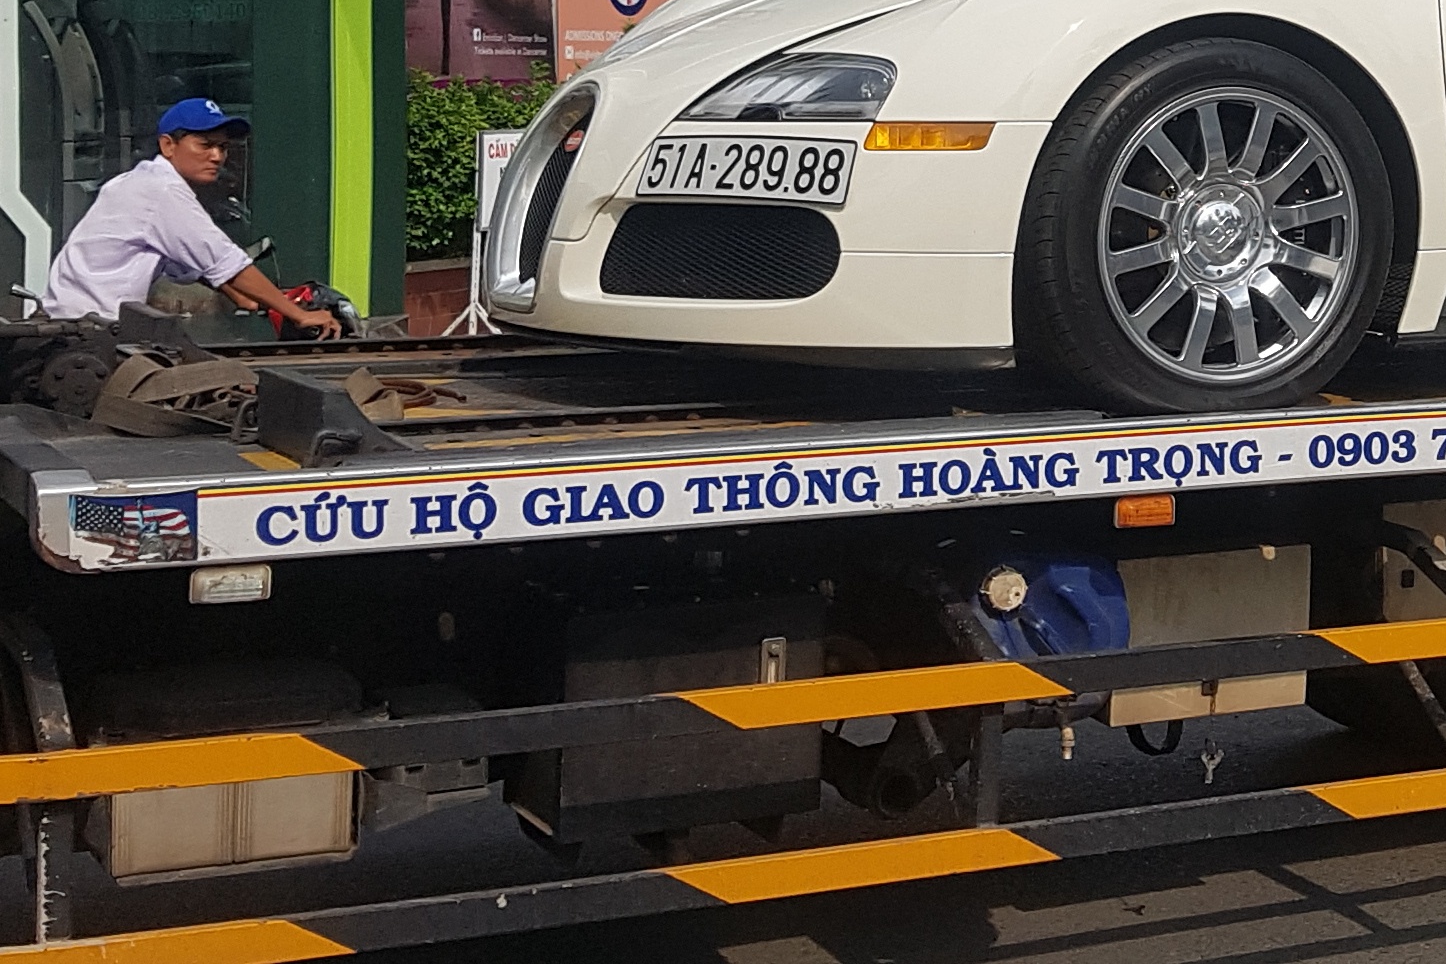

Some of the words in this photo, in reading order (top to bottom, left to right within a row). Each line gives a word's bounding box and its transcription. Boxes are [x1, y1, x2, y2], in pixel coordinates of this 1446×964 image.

[488, 137, 508, 159] CẤM
[256, 491, 388, 547] CỨU
[410, 482, 497, 540] HỘ
[521, 481, 666, 528] GIAO
[685, 460, 881, 515] THÔNG
[899, 447, 1080, 499] HOÀNG
[1096, 439, 1263, 488] TRỌNG
[1277, 452, 1293, 462] -
[1308, 429, 1417, 469] 0903
